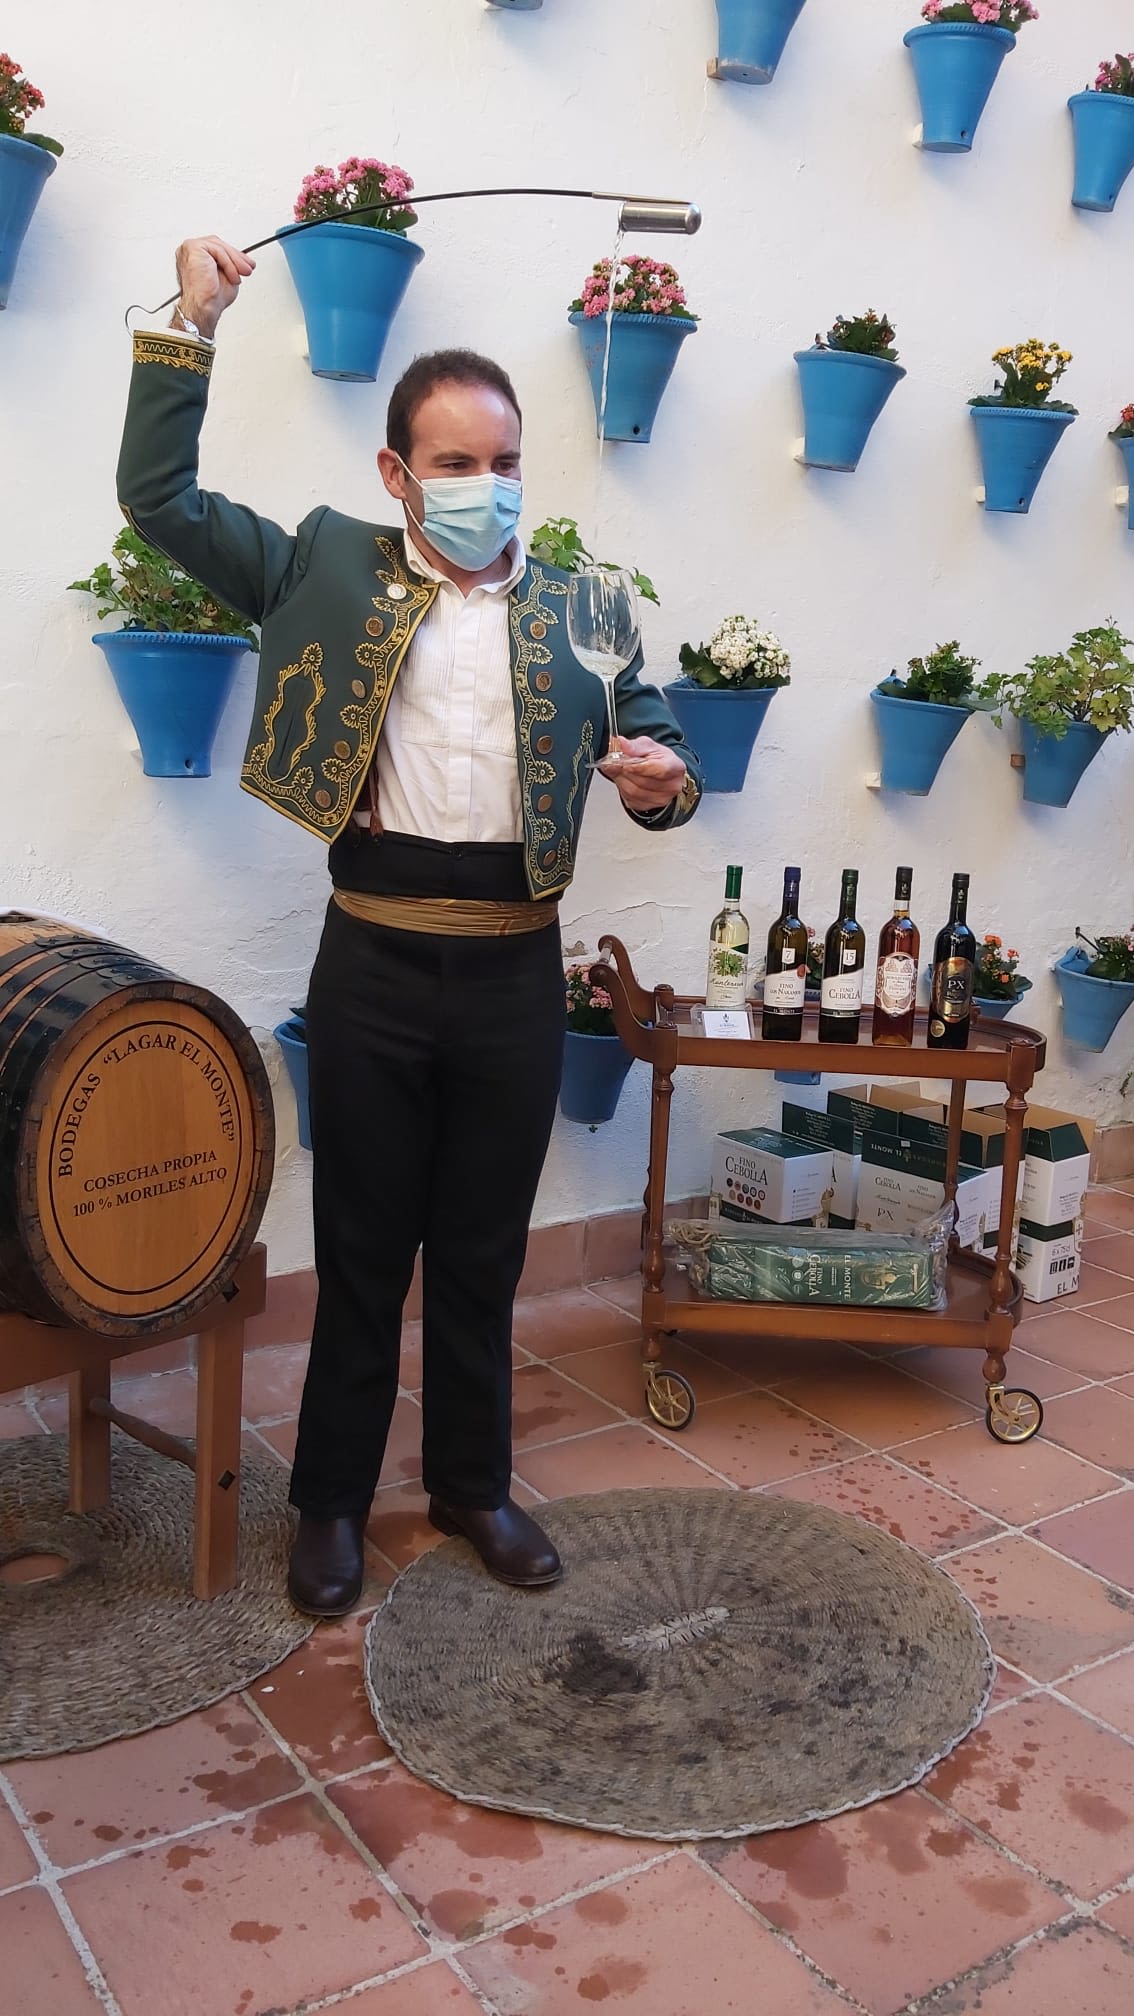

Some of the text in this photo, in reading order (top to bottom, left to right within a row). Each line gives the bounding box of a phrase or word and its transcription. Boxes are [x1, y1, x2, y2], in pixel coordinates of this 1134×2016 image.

[785, 950, 791, 959] 7
[845, 952, 854, 961] 15
[829, 988, 861, 1000] CEBOLLA
[948, 980, 965, 989] PX
[58, 1073, 101, 1178] BODEGAS
[179, 1040, 200, 1066] EL
[84, 1149, 217, 1192] COSECHA PROPIA
[725, 1156, 768, 1186] CEBOLLA
[739, 1156, 756, 1169] FINO
[73, 1167, 228, 1217] 100 % MORILES ALTO
[808, 1254, 821, 1297] CEBOLLA
[844, 1267, 852, 1300] MONTE
[1057, 1281, 1068, 1295] EL
